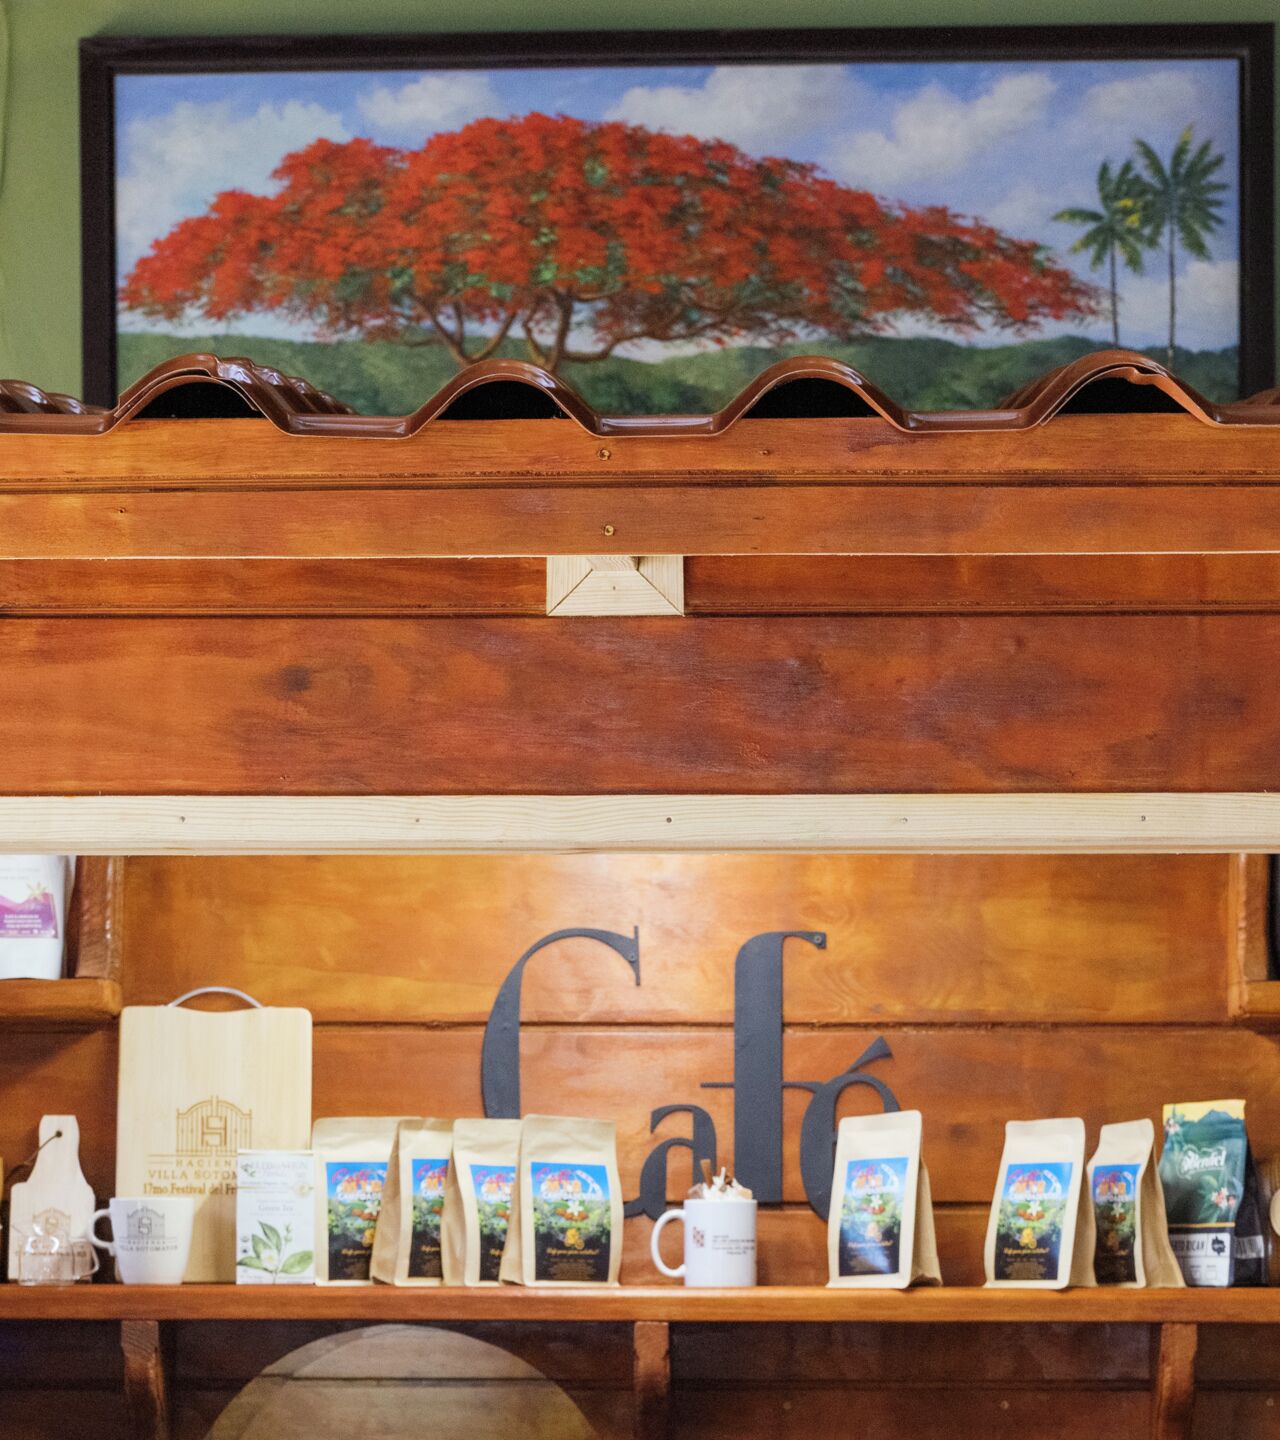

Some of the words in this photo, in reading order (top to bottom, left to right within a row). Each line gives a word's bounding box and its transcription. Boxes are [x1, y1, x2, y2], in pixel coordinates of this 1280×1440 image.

[481, 926, 902, 1222] Café
[176, 1159, 237, 1168] HACIEN
[148, 1169, 188, 1179] VILLA
[171, 1183, 206, 1195] Festival
